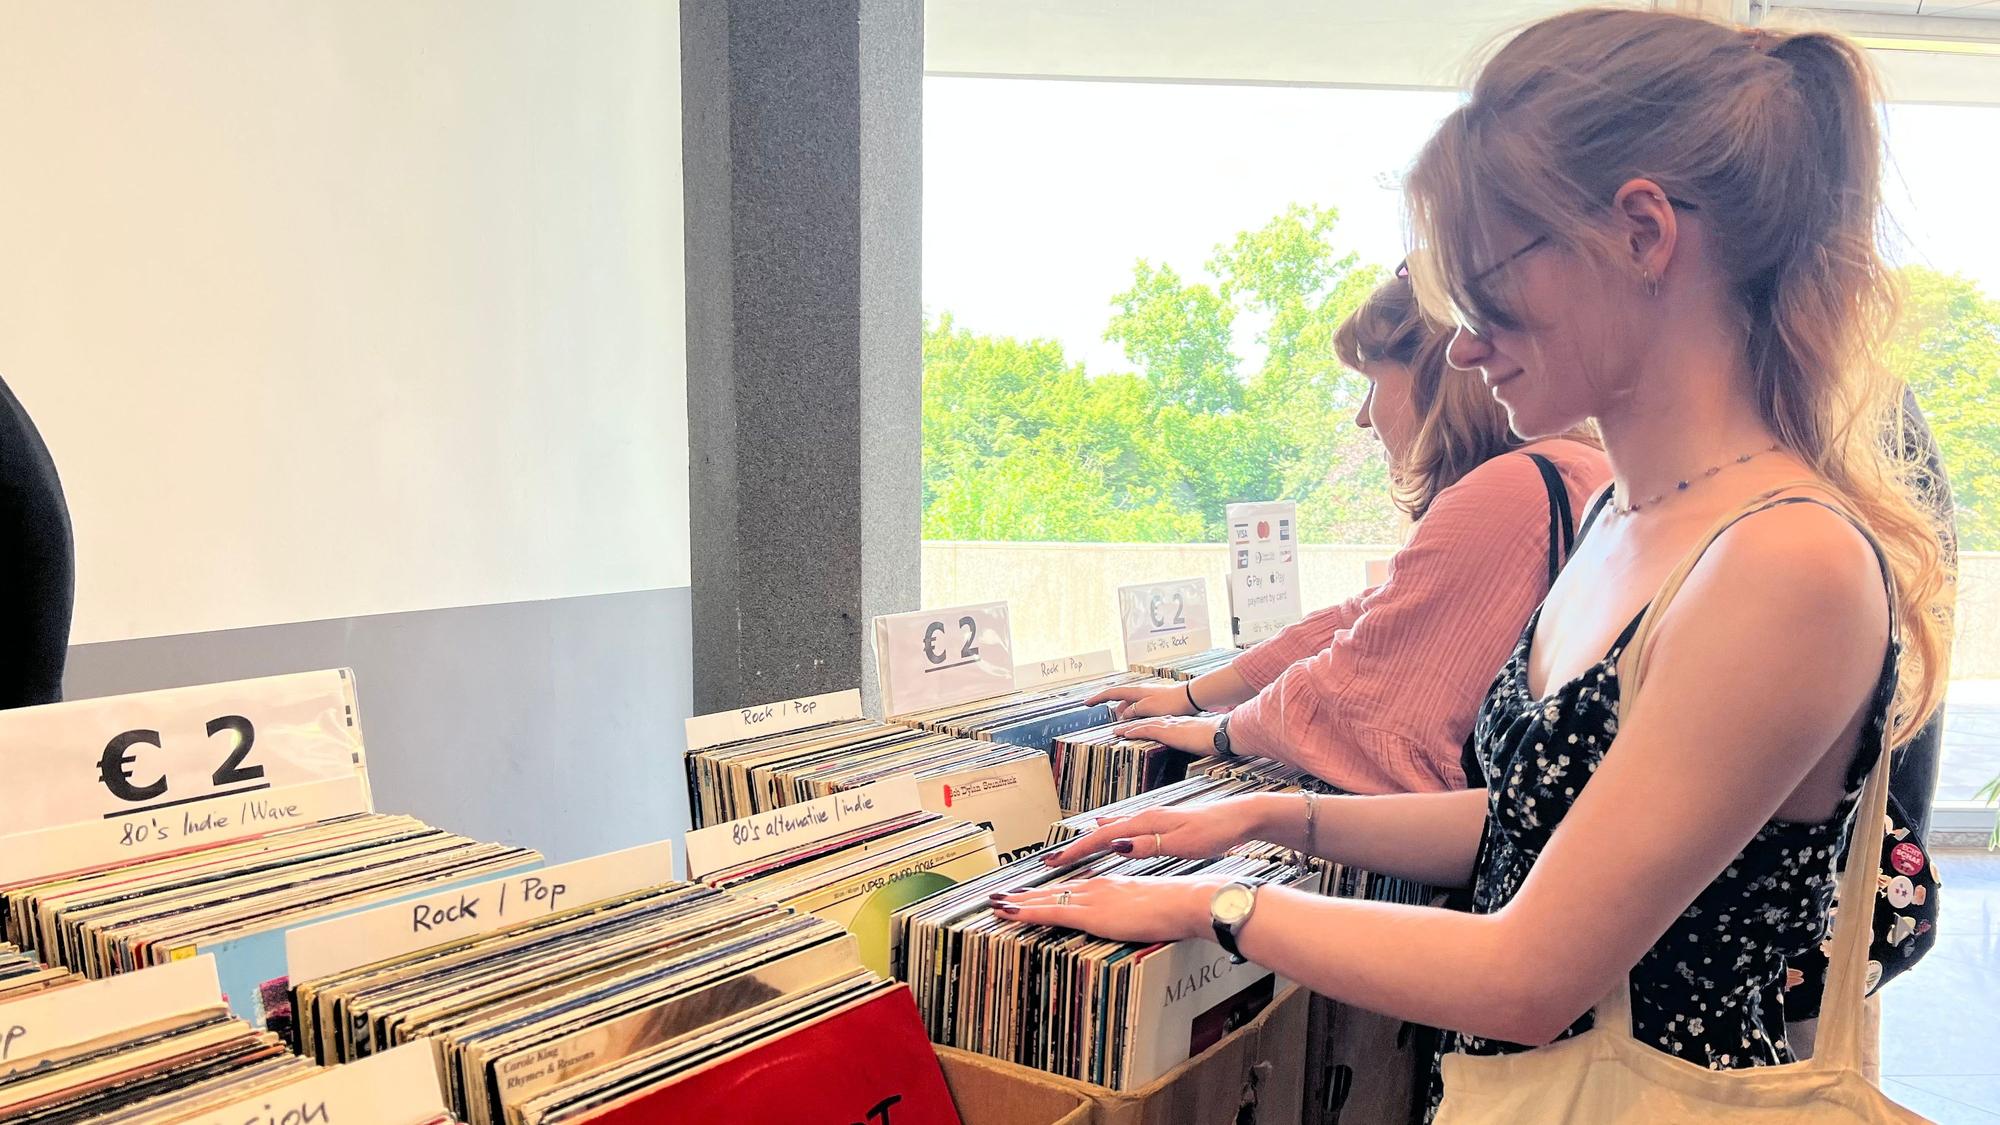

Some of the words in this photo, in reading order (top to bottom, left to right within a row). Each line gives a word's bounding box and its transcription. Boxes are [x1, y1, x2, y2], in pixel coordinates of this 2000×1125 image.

[1236, 529, 1248, 538] VISA
[1150, 594, 1165, 628] €
[1173, 592, 1185, 625] 2
[923, 621, 947, 665] €
[959, 616, 979, 659] 2
[1171, 635, 1189, 647] Rock
[1040, 662, 1059, 677] Rock
[1069, 657, 1083, 672] Pop
[741, 705, 773, 725] Rock
[794, 701, 817, 715] Pop
[96, 728, 169, 803] €
[205, 714, 265, 787] 2
[961, 785, 982, 796] Dylan
[983, 776, 1018, 790] Soundtrack
[119, 818, 169, 846] 80's
[182, 811, 229, 837] Indie
[732, 819, 761, 846] 80's
[766, 805, 829, 836] alternative
[860, 877, 887, 894] SUPER
[886, 867, 913, 886] SOUND
[412, 895, 480, 933] Rock
[520, 877, 567, 910] Pop
[1162, 955, 1234, 1008] MARC
[503, 1055, 536, 1074] Carole
[537, 1047, 559, 1062] King
[507, 1068, 545, 1090] Rhymes
[547, 1062, 555, 1074] &
[557, 1051, 596, 1071] Reasons
